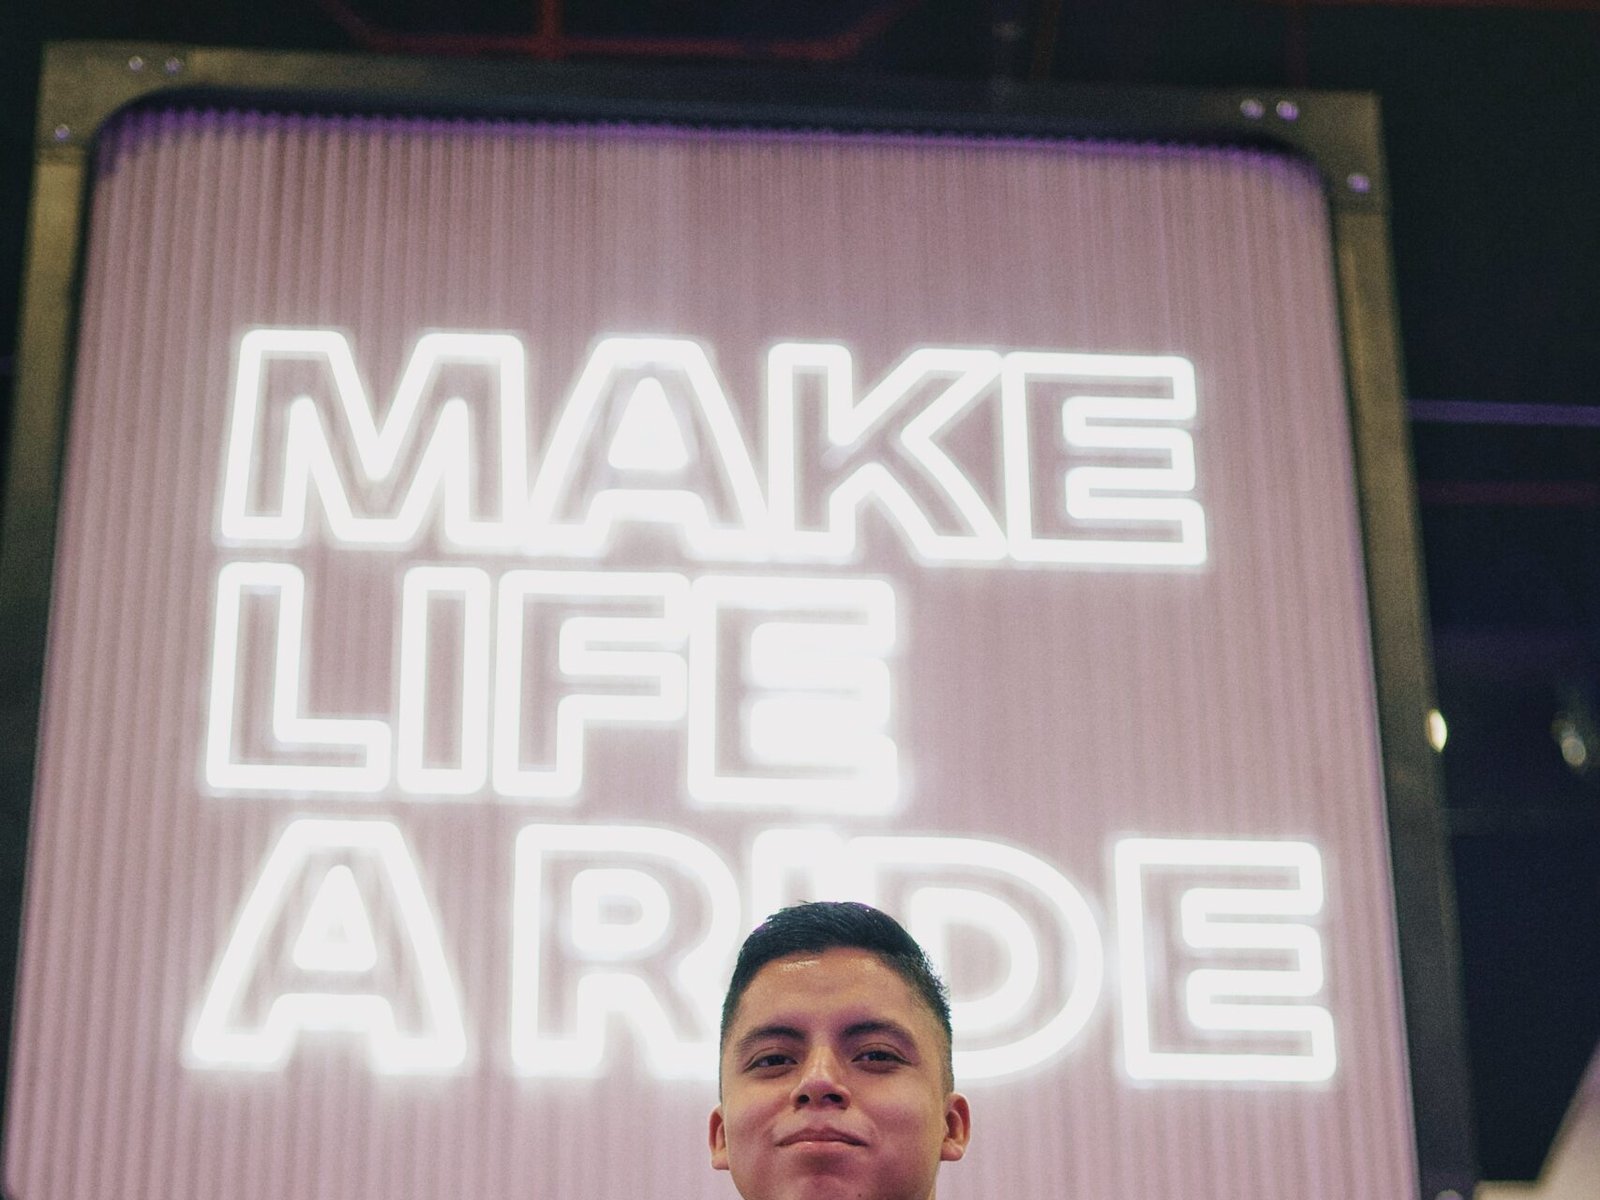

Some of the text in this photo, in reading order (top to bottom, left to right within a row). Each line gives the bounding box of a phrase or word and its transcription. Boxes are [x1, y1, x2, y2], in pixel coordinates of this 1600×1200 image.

[217, 328, 1209, 567] MAKE
[205, 562, 899, 805] LIFE
[187, 816, 1338, 1086] A RDE
